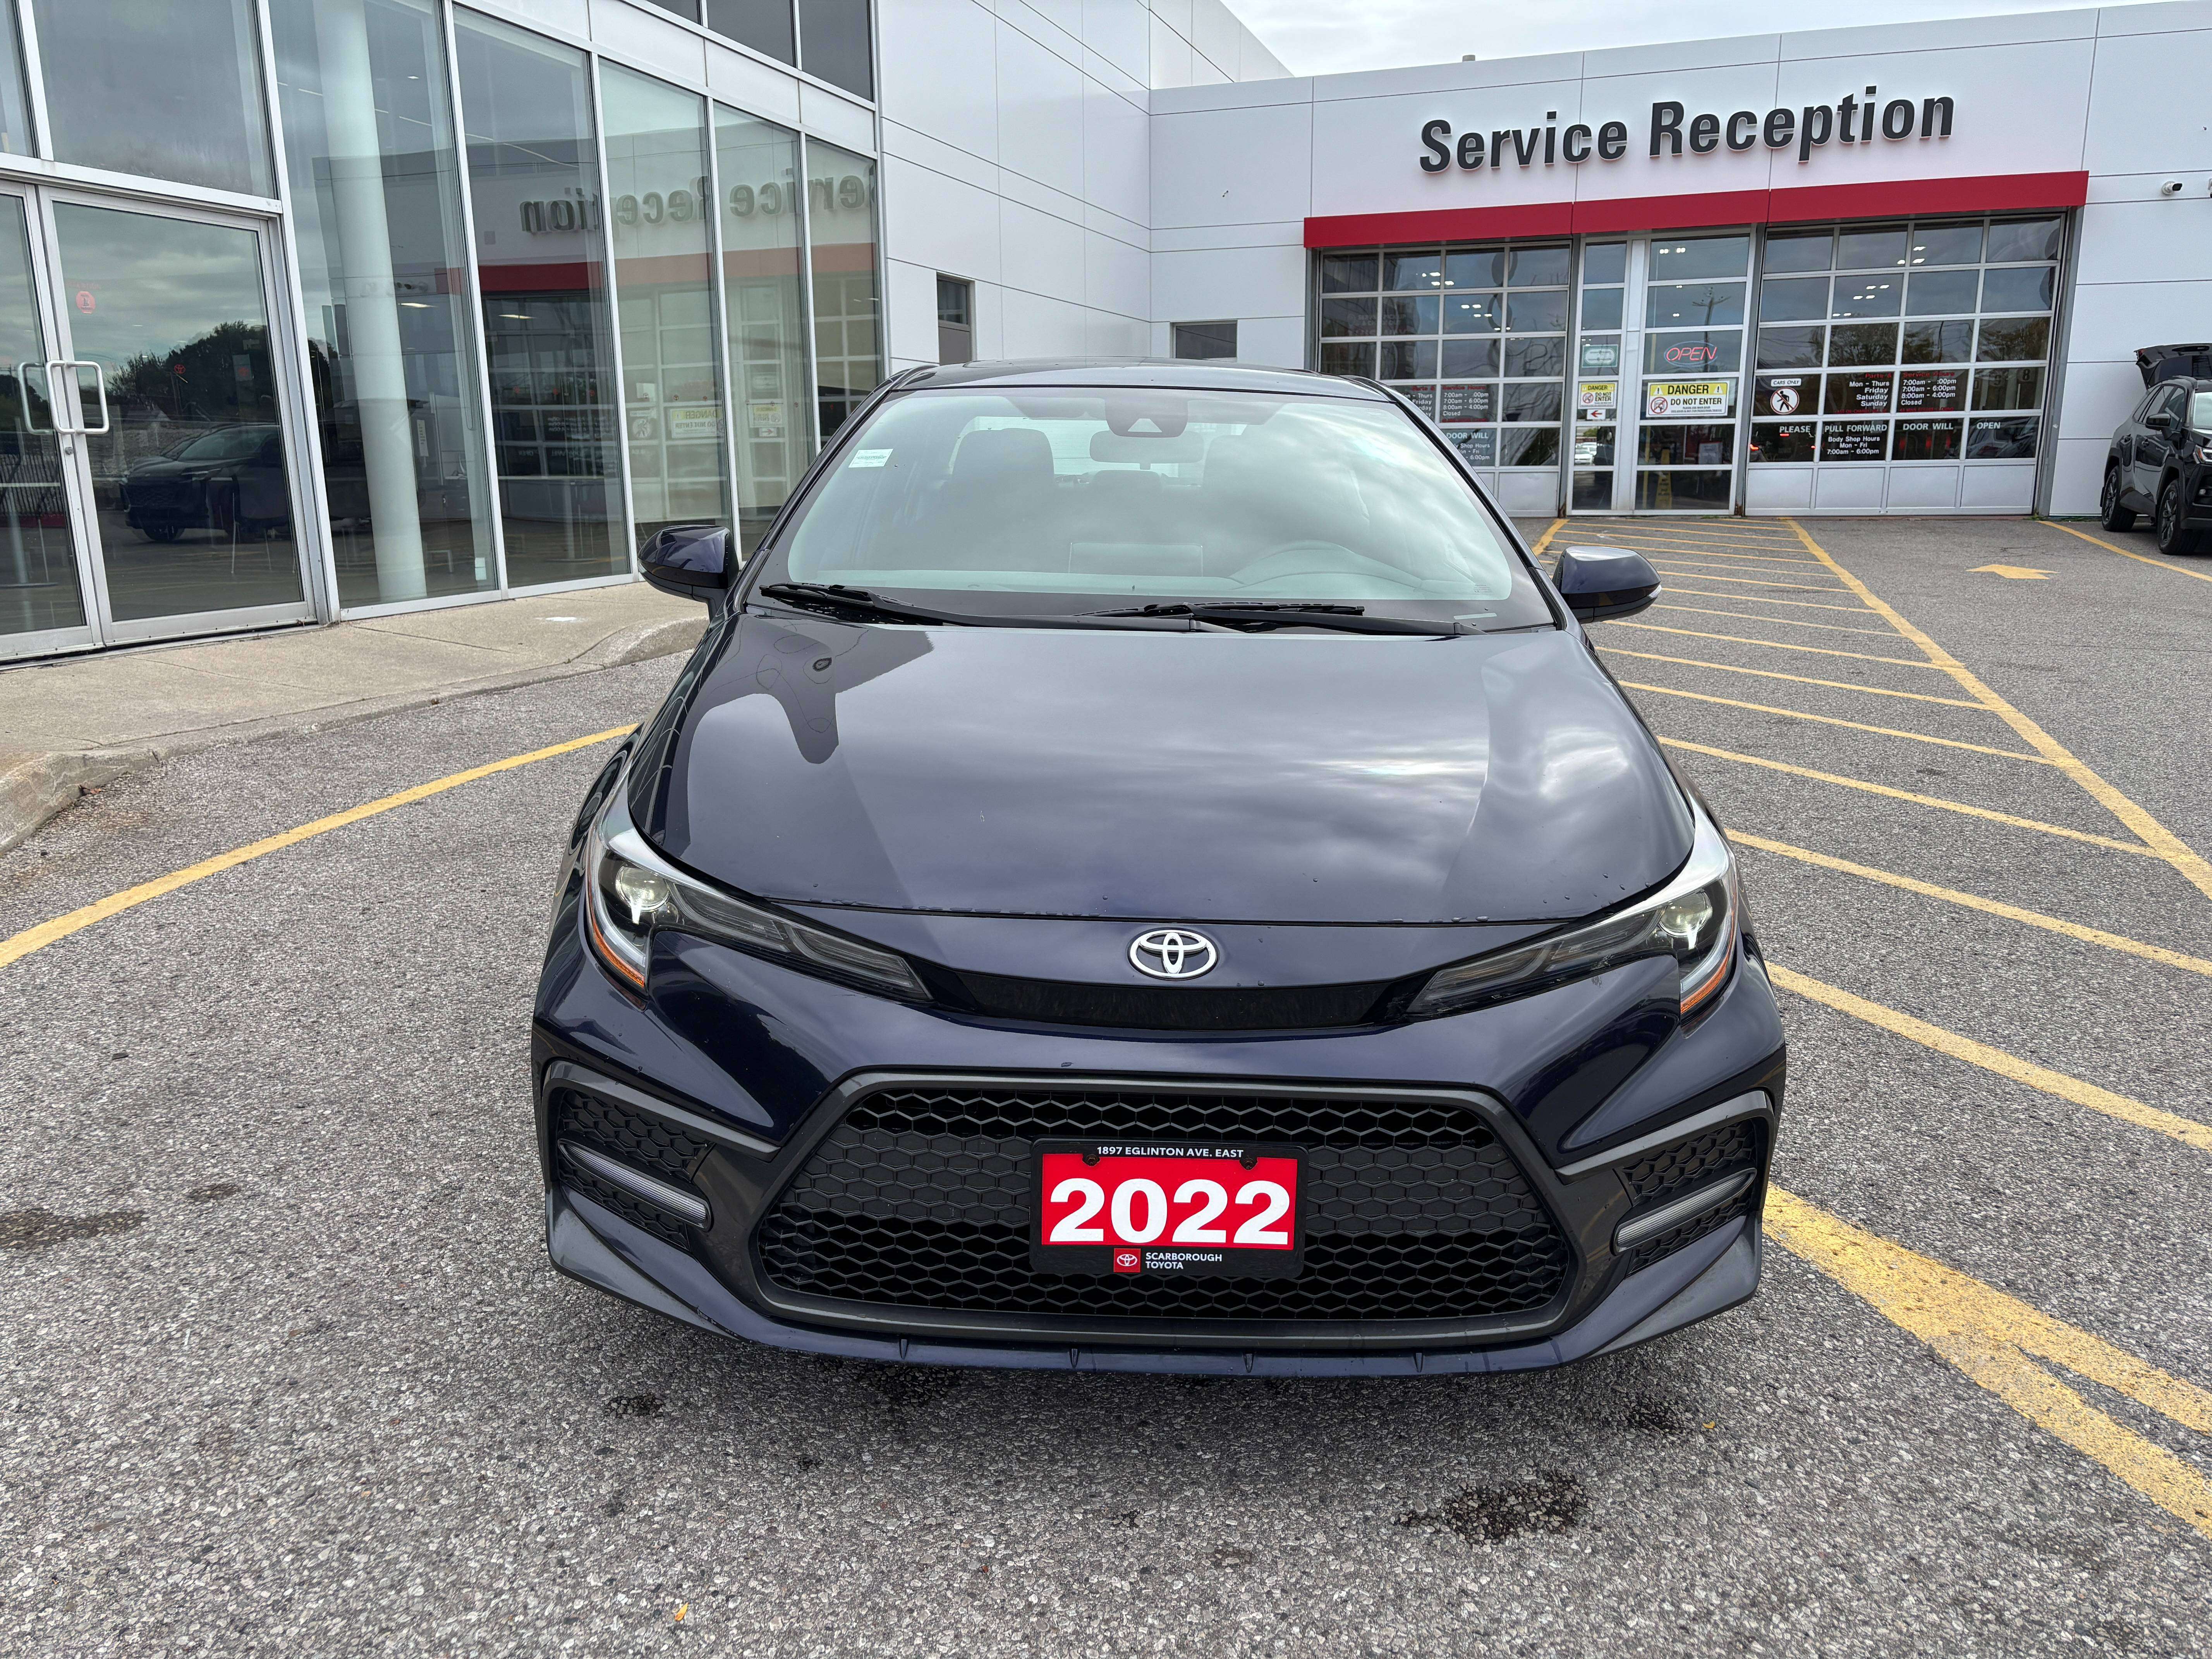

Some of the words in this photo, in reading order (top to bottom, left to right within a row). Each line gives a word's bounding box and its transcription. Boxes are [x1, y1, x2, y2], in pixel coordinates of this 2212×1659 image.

[1419, 111, 1627, 173] Service
[1649, 85, 1954, 163] Reception
[1666, 347, 1717, 361] OPEN
[1668, 385, 1709, 394] DANGER
[1097, 1146, 1122, 1155] 1897
[1125, 1147, 1183, 1156] EGLINTON
[1187, 1147, 1213, 1157] AVE.
[1215, 1149, 1244, 1158] EAST
[1049, 1178, 1290, 1245] 2022
[1146, 1252, 1222, 1262] SCARBOROUGH
[1146, 1261, 1184, 1270] TOYOTA
